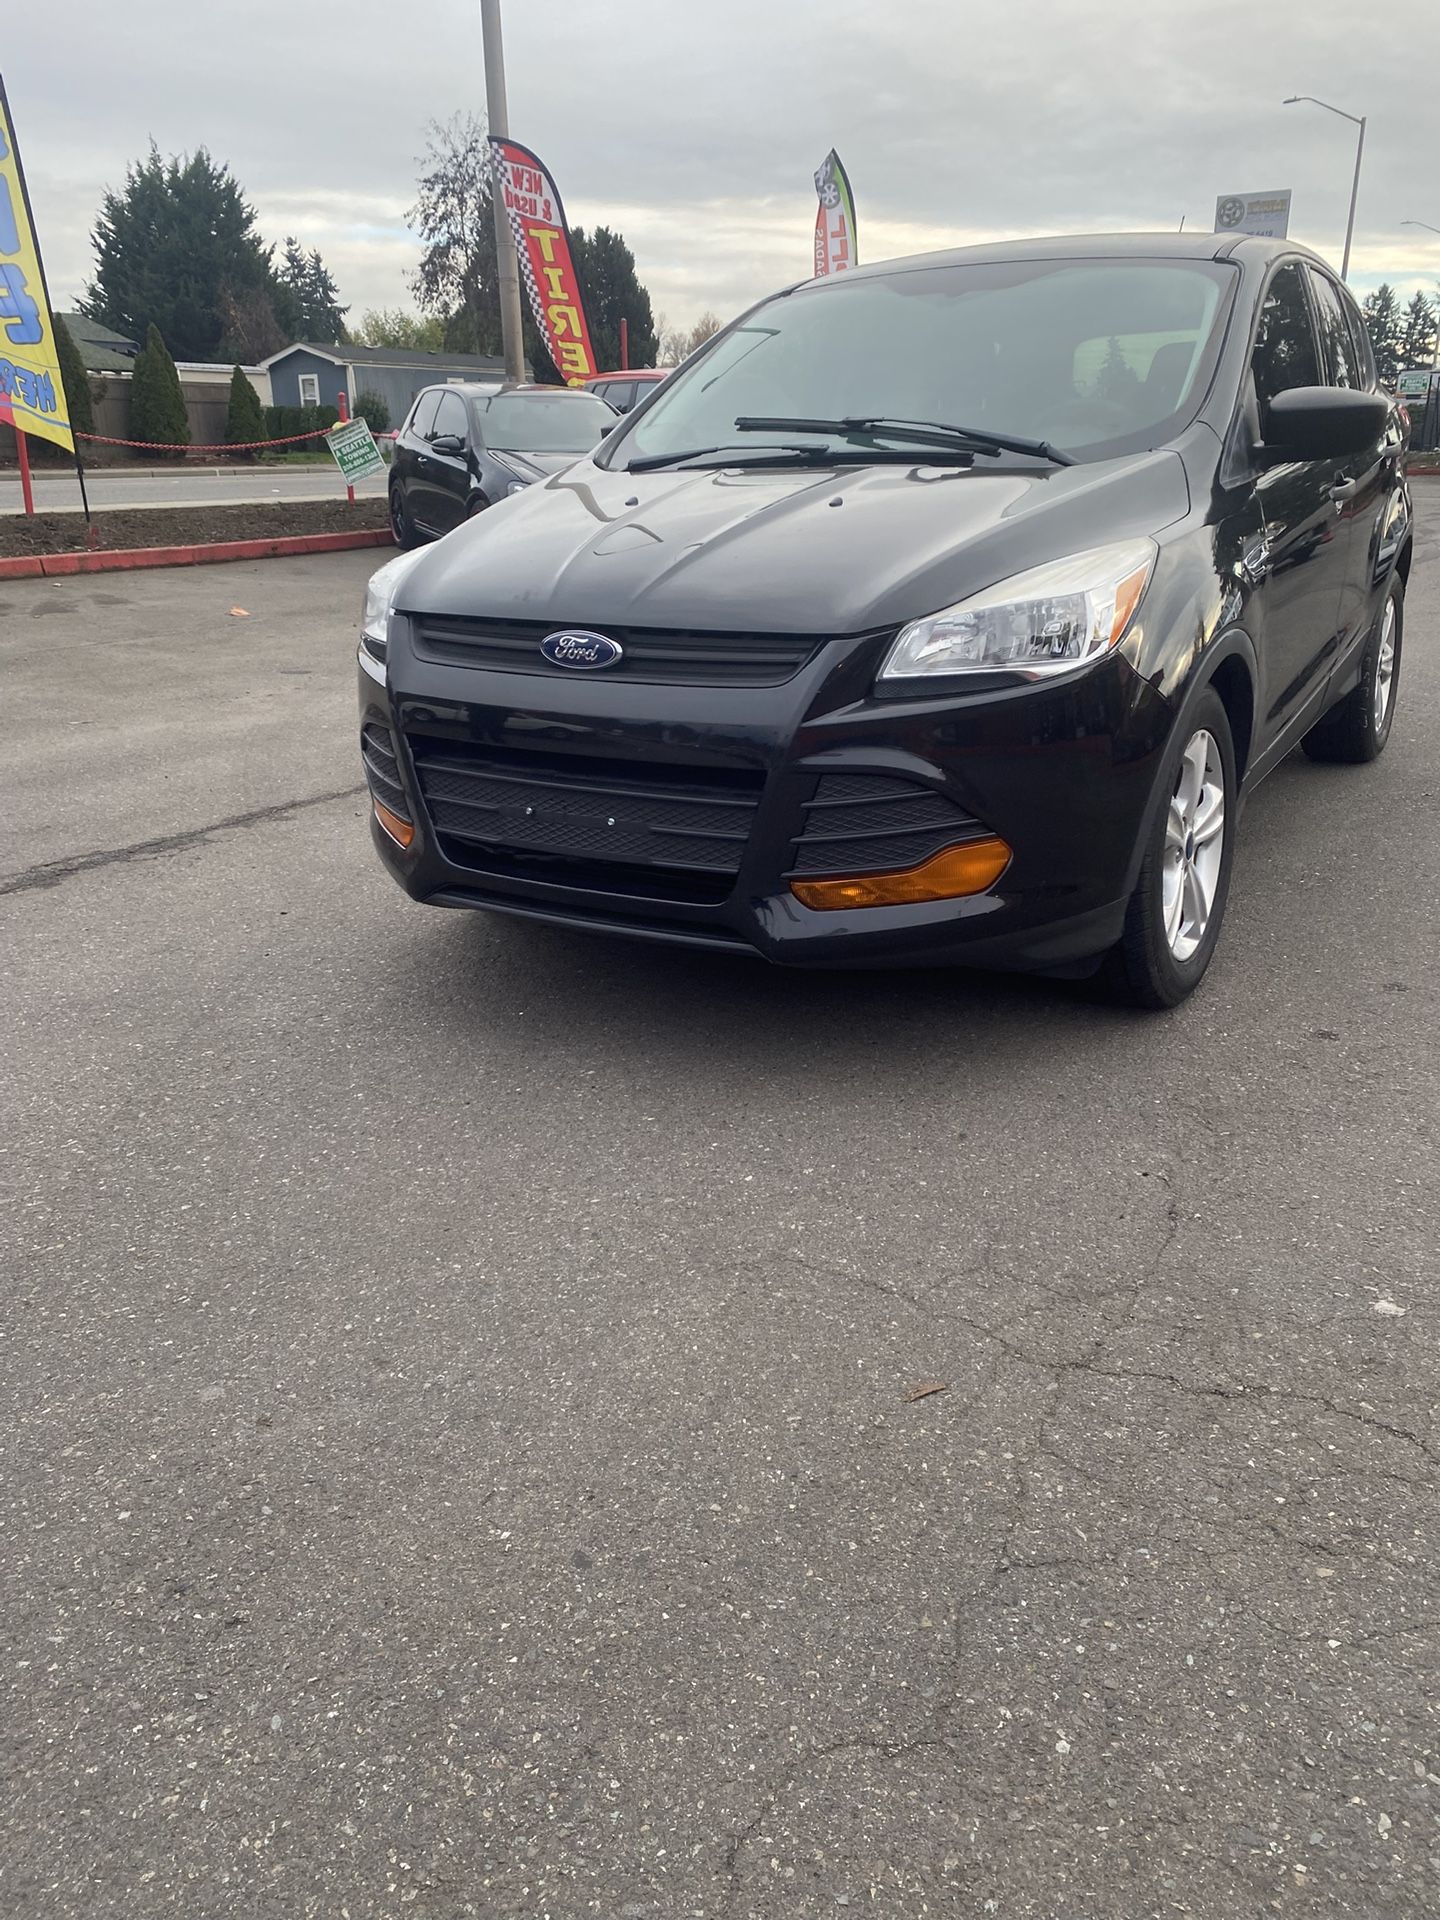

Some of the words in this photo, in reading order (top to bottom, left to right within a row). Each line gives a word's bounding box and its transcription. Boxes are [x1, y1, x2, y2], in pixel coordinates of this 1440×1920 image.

[341, 436, 372, 455] SEATTLE
[344, 446, 370, 462] TOWING
[555, 636, 599, 661] Ford
